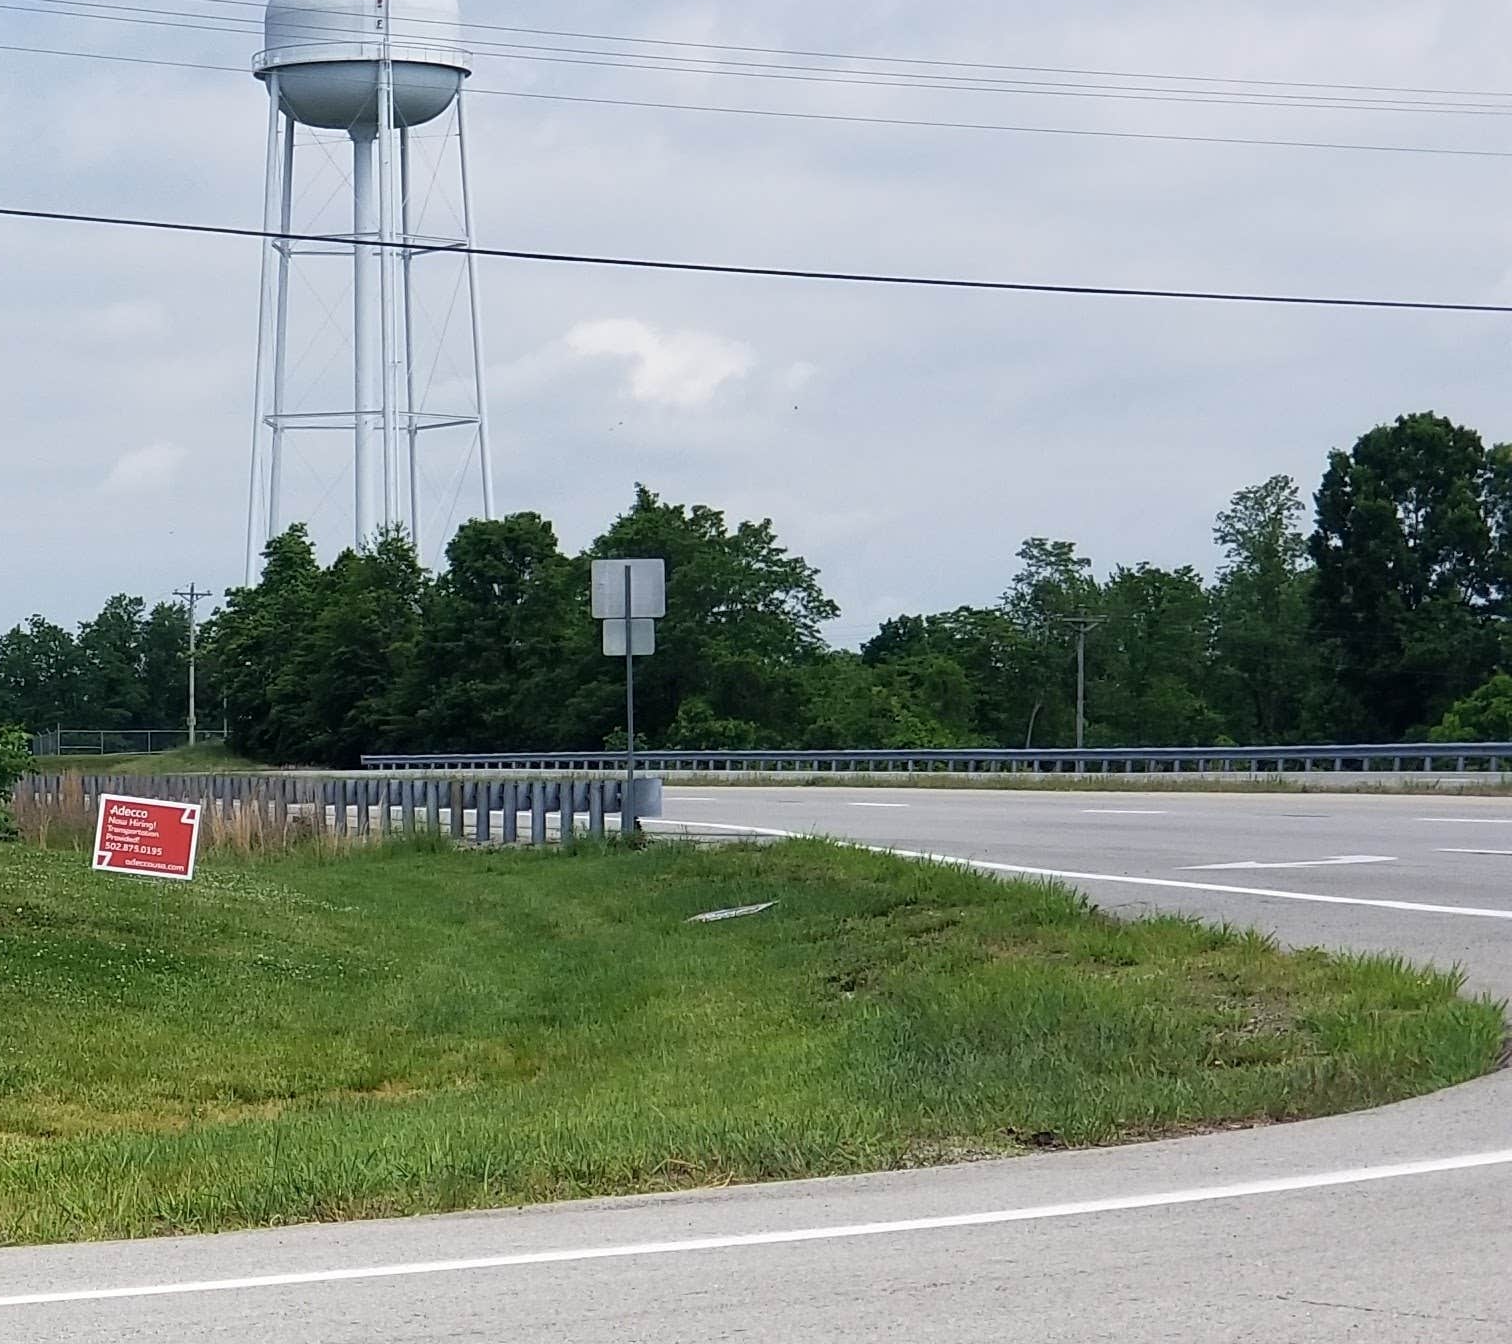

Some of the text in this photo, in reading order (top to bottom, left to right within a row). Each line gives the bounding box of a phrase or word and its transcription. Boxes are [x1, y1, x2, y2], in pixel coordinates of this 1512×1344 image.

[110, 805, 148, 818] Adecco
[108, 816, 156, 830] Now Hiring!
